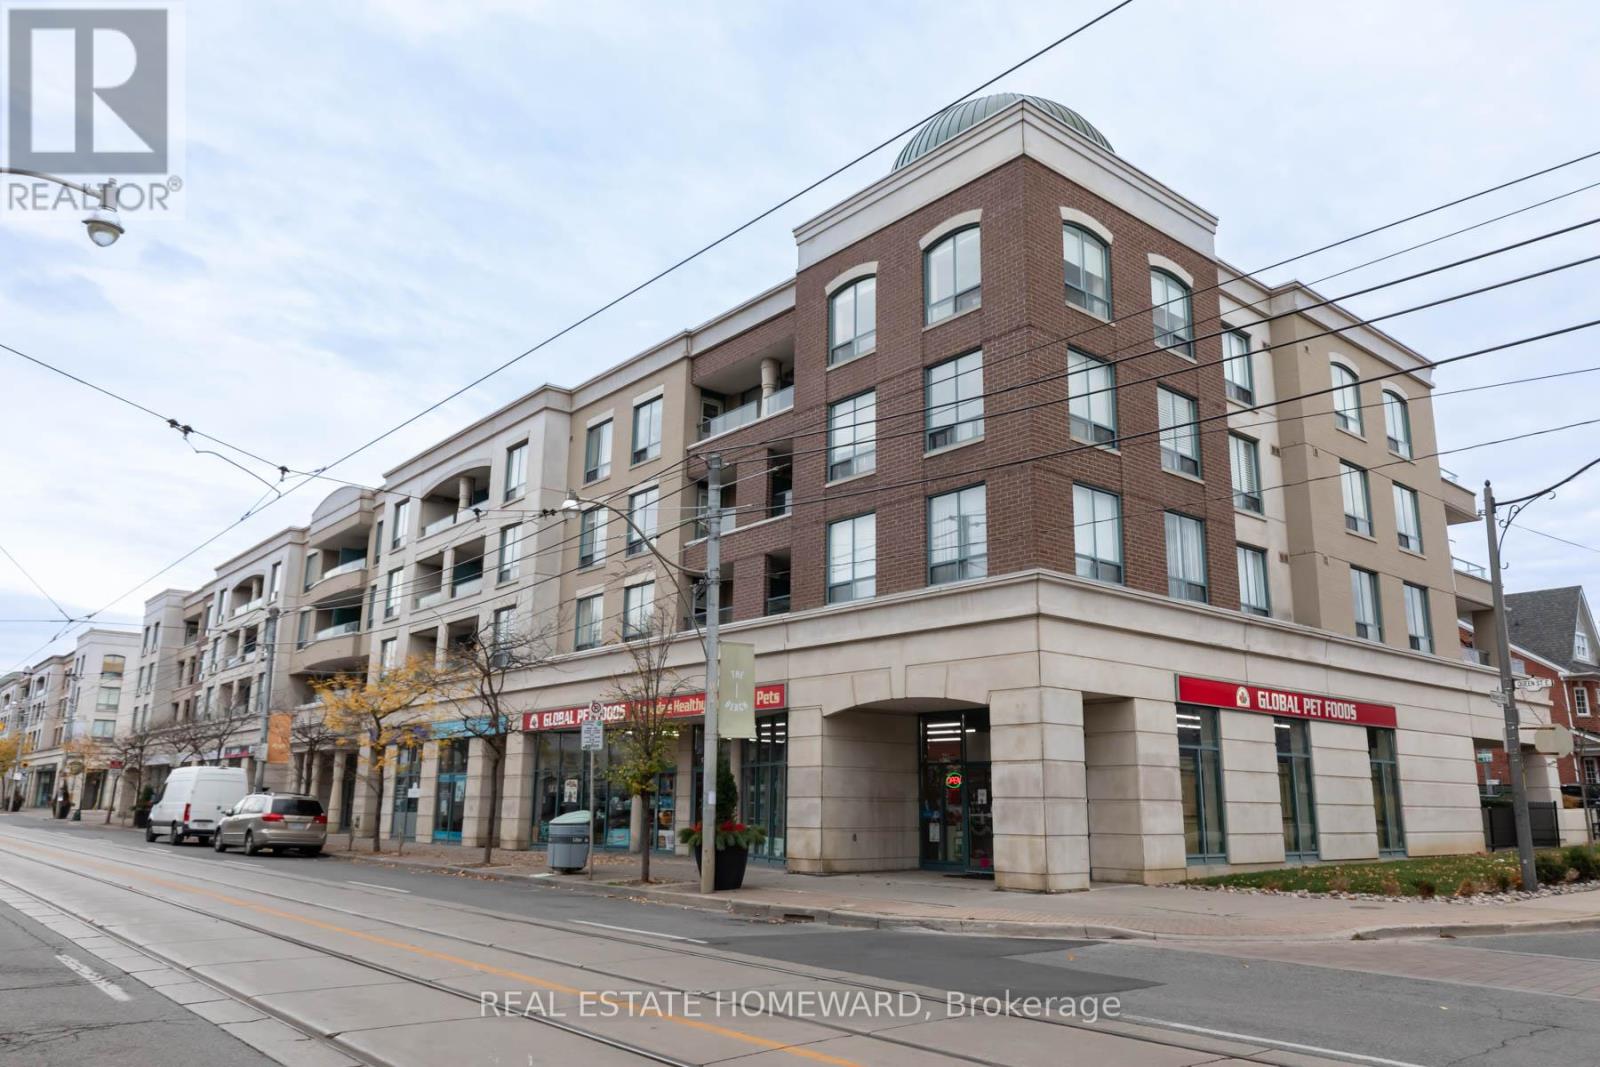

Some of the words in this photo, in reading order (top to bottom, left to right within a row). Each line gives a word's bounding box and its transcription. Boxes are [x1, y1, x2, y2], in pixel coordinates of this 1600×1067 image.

[756, 690, 780, 705] Pets
[1257, 690, 1301, 714] GLOBAL
[1303, 697, 1322, 716] PET
[1325, 700, 1357, 720] FOODS
[543, 709, 575, 727] GLOBAL
[577, 707, 592, 724] PE
[601, 704, 626, 720] OODS
